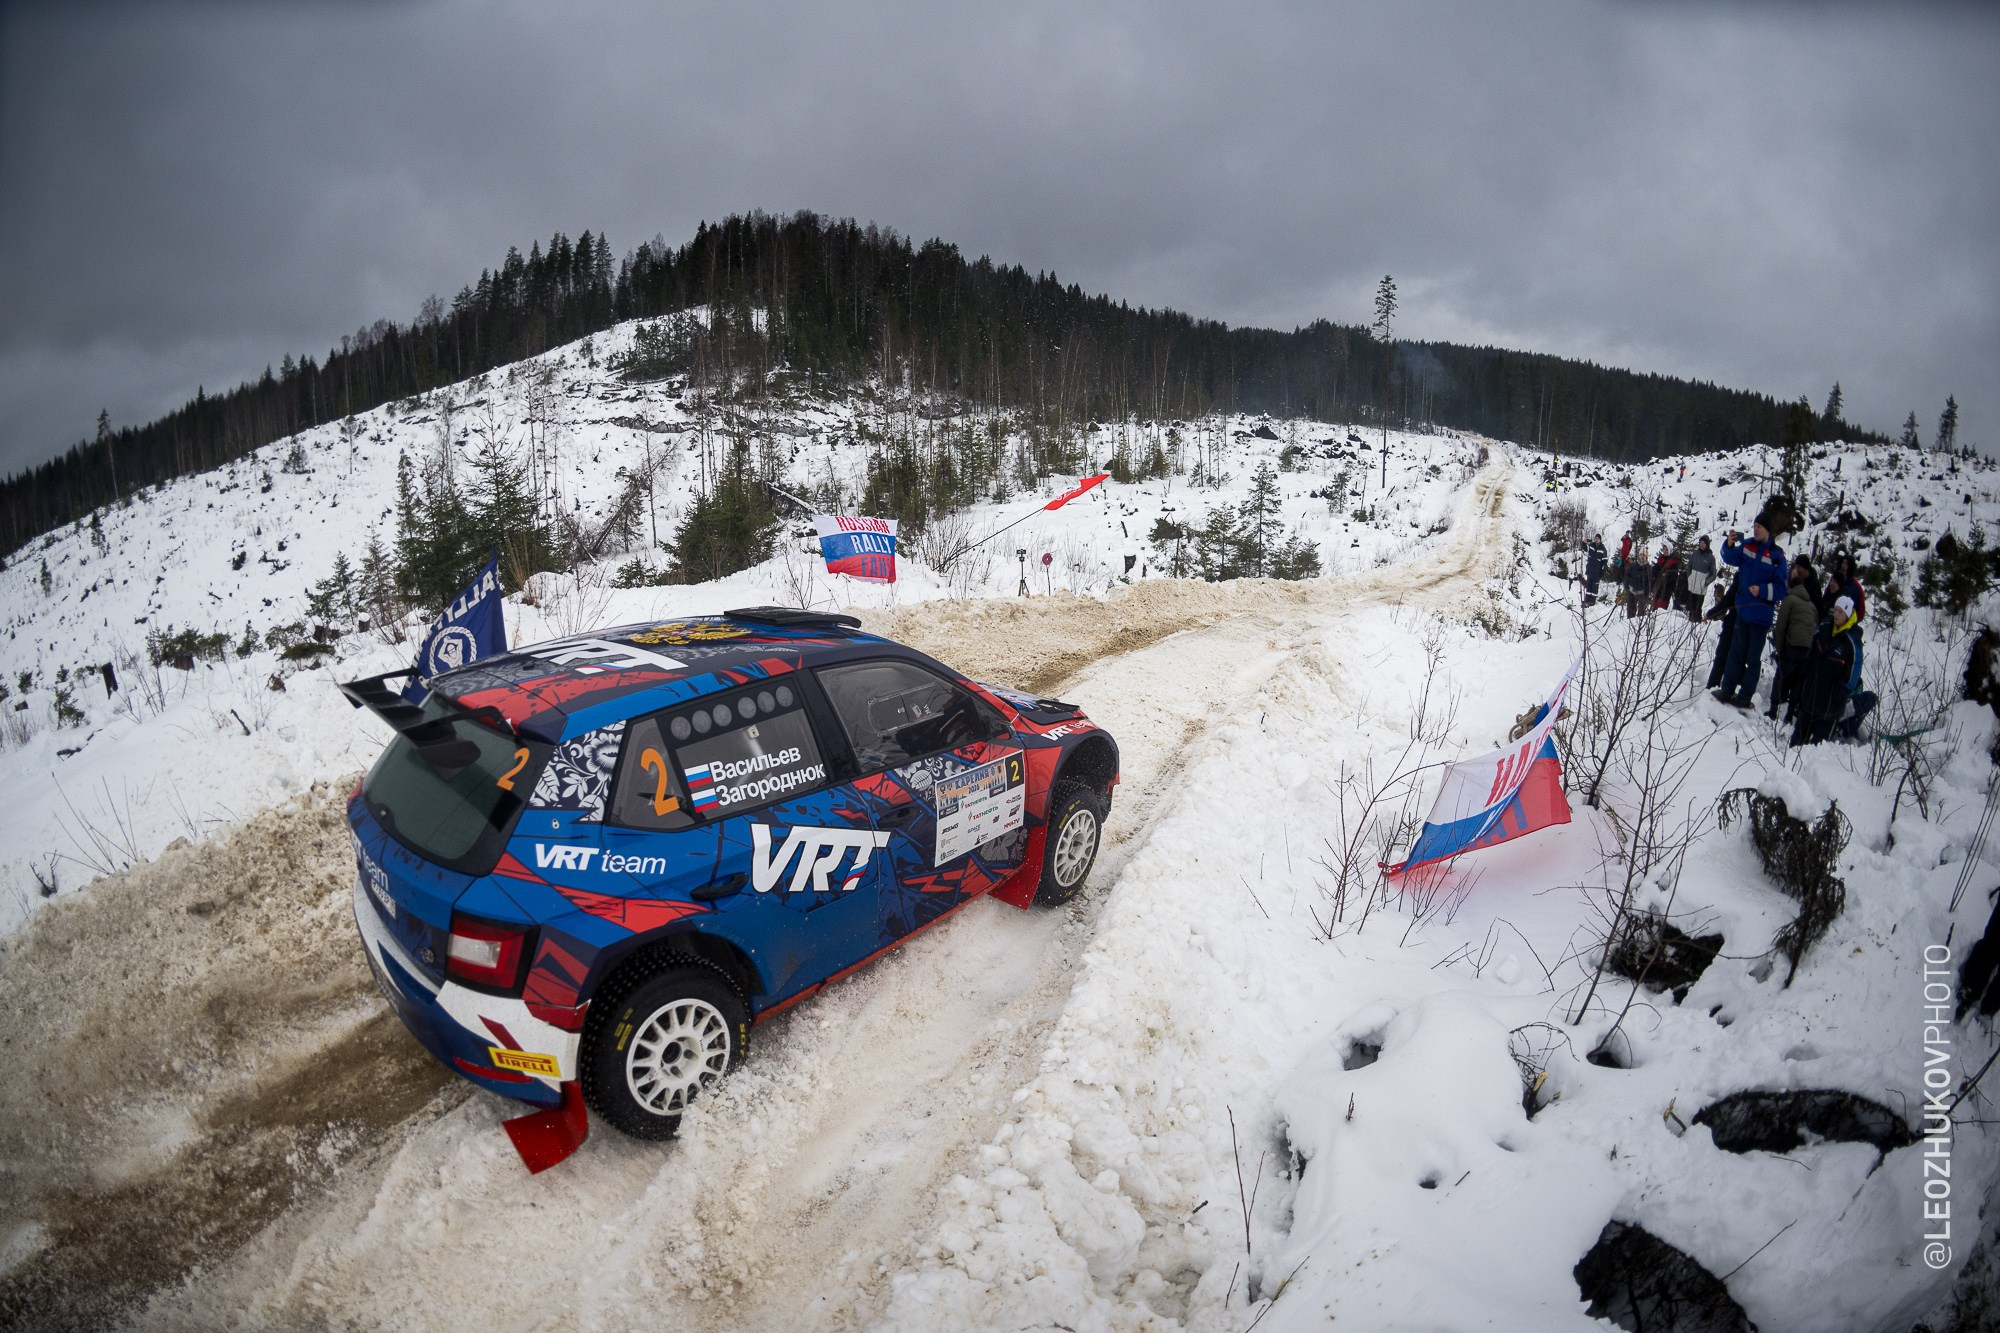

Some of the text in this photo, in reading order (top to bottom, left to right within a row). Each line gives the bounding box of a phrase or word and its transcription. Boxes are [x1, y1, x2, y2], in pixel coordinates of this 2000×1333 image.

[835, 516, 891, 534] RUSSIAN
[850, 533, 892, 554] RALLY
[861, 556, 894, 577] FANS
[1041, 725, 1074, 741] VRT
[496, 747, 531, 791] 2
[709, 747, 802, 782] Васильев
[1010, 760, 1020, 782] 2
[640, 748, 680, 817] 2
[716, 763, 827, 806] Загороднюк
[535, 843, 667, 875] VRT team
[751, 823, 892, 893] VRT
[495, 1051, 553, 1073] PIRELLI
